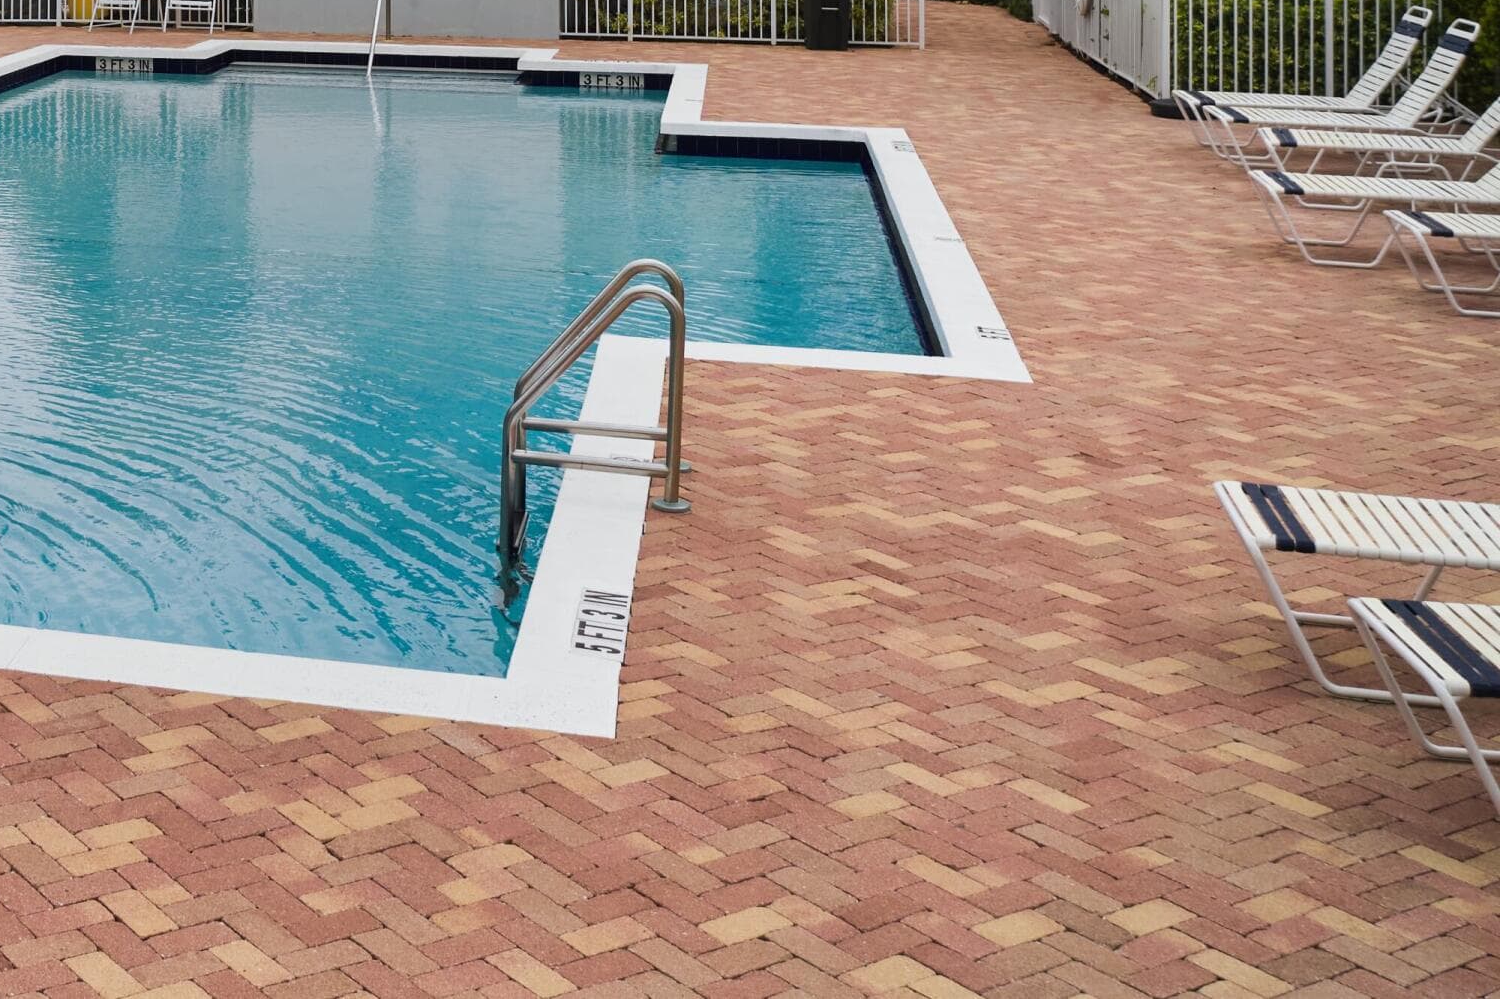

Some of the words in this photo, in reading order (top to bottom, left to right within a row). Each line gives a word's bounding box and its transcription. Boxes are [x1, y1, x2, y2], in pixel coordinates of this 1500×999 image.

[99, 58, 107, 70] 3
[128, 59, 135, 70] 3
[139, 59, 153, 71] IN.
[584, 74, 592, 85] 3
[616, 75, 624, 86] 3
[583, 589, 629, 607] IN
[581, 609, 626, 620] 3
[577, 620, 624, 642] FT
[575, 642, 621, 654] 5
